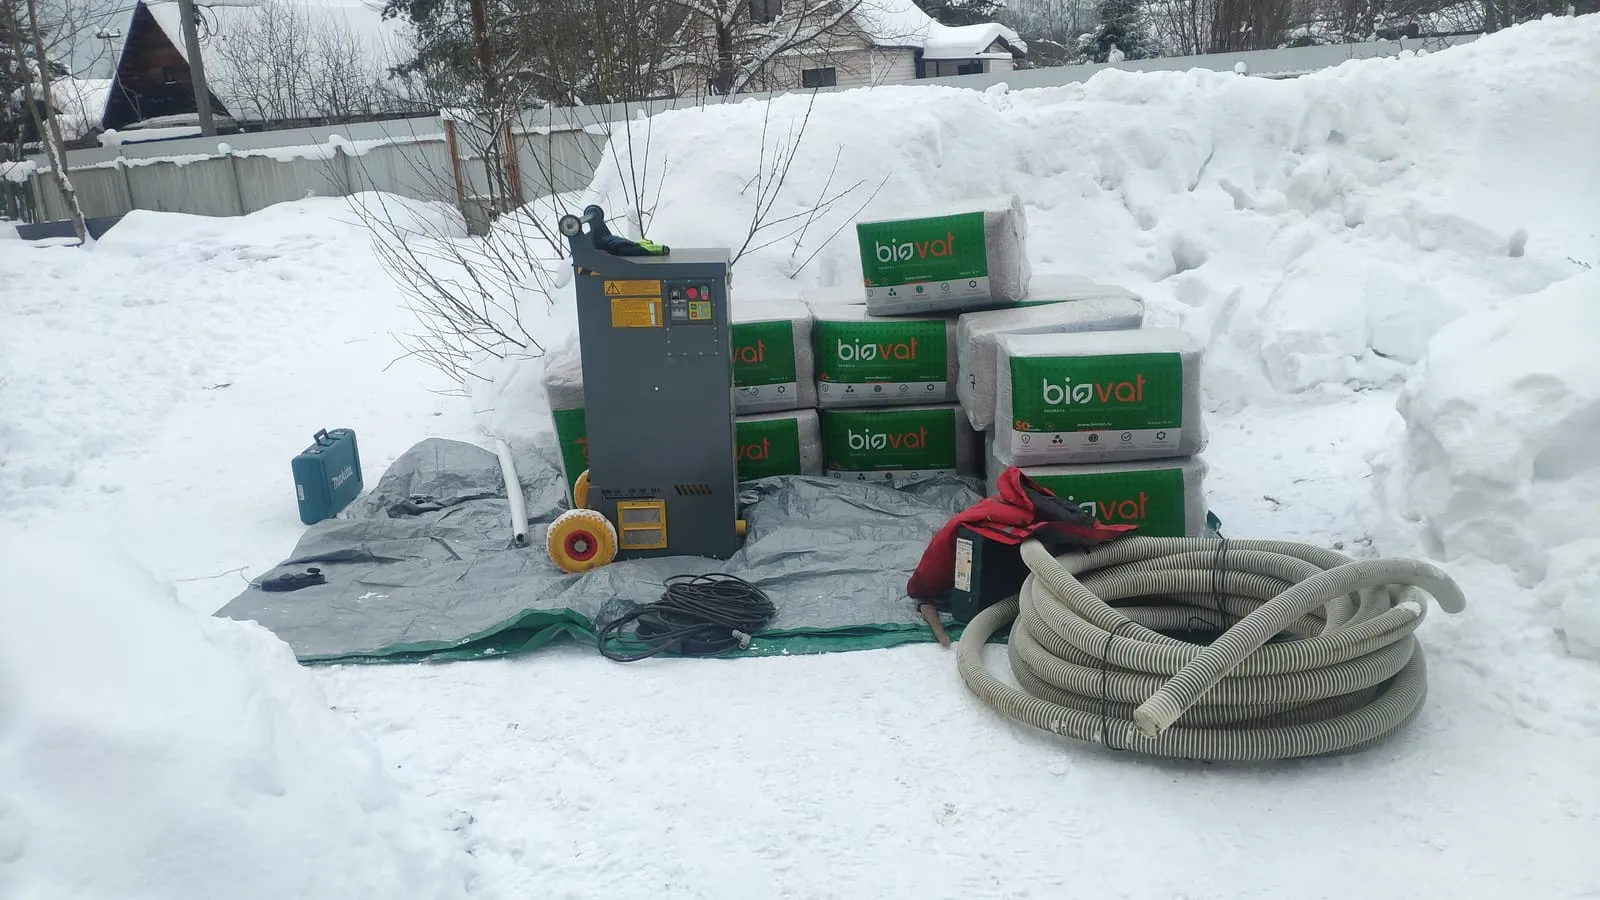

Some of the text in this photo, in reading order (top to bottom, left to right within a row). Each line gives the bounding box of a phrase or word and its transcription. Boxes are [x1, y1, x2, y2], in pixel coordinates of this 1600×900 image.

[875, 231, 955, 263] biovat
[733, 339, 765, 363] vat
[837, 336, 918, 361] biovat
[1043, 373, 1146, 405] biovat
[737, 436, 770, 461] vat
[848, 425, 928, 450] biovat
